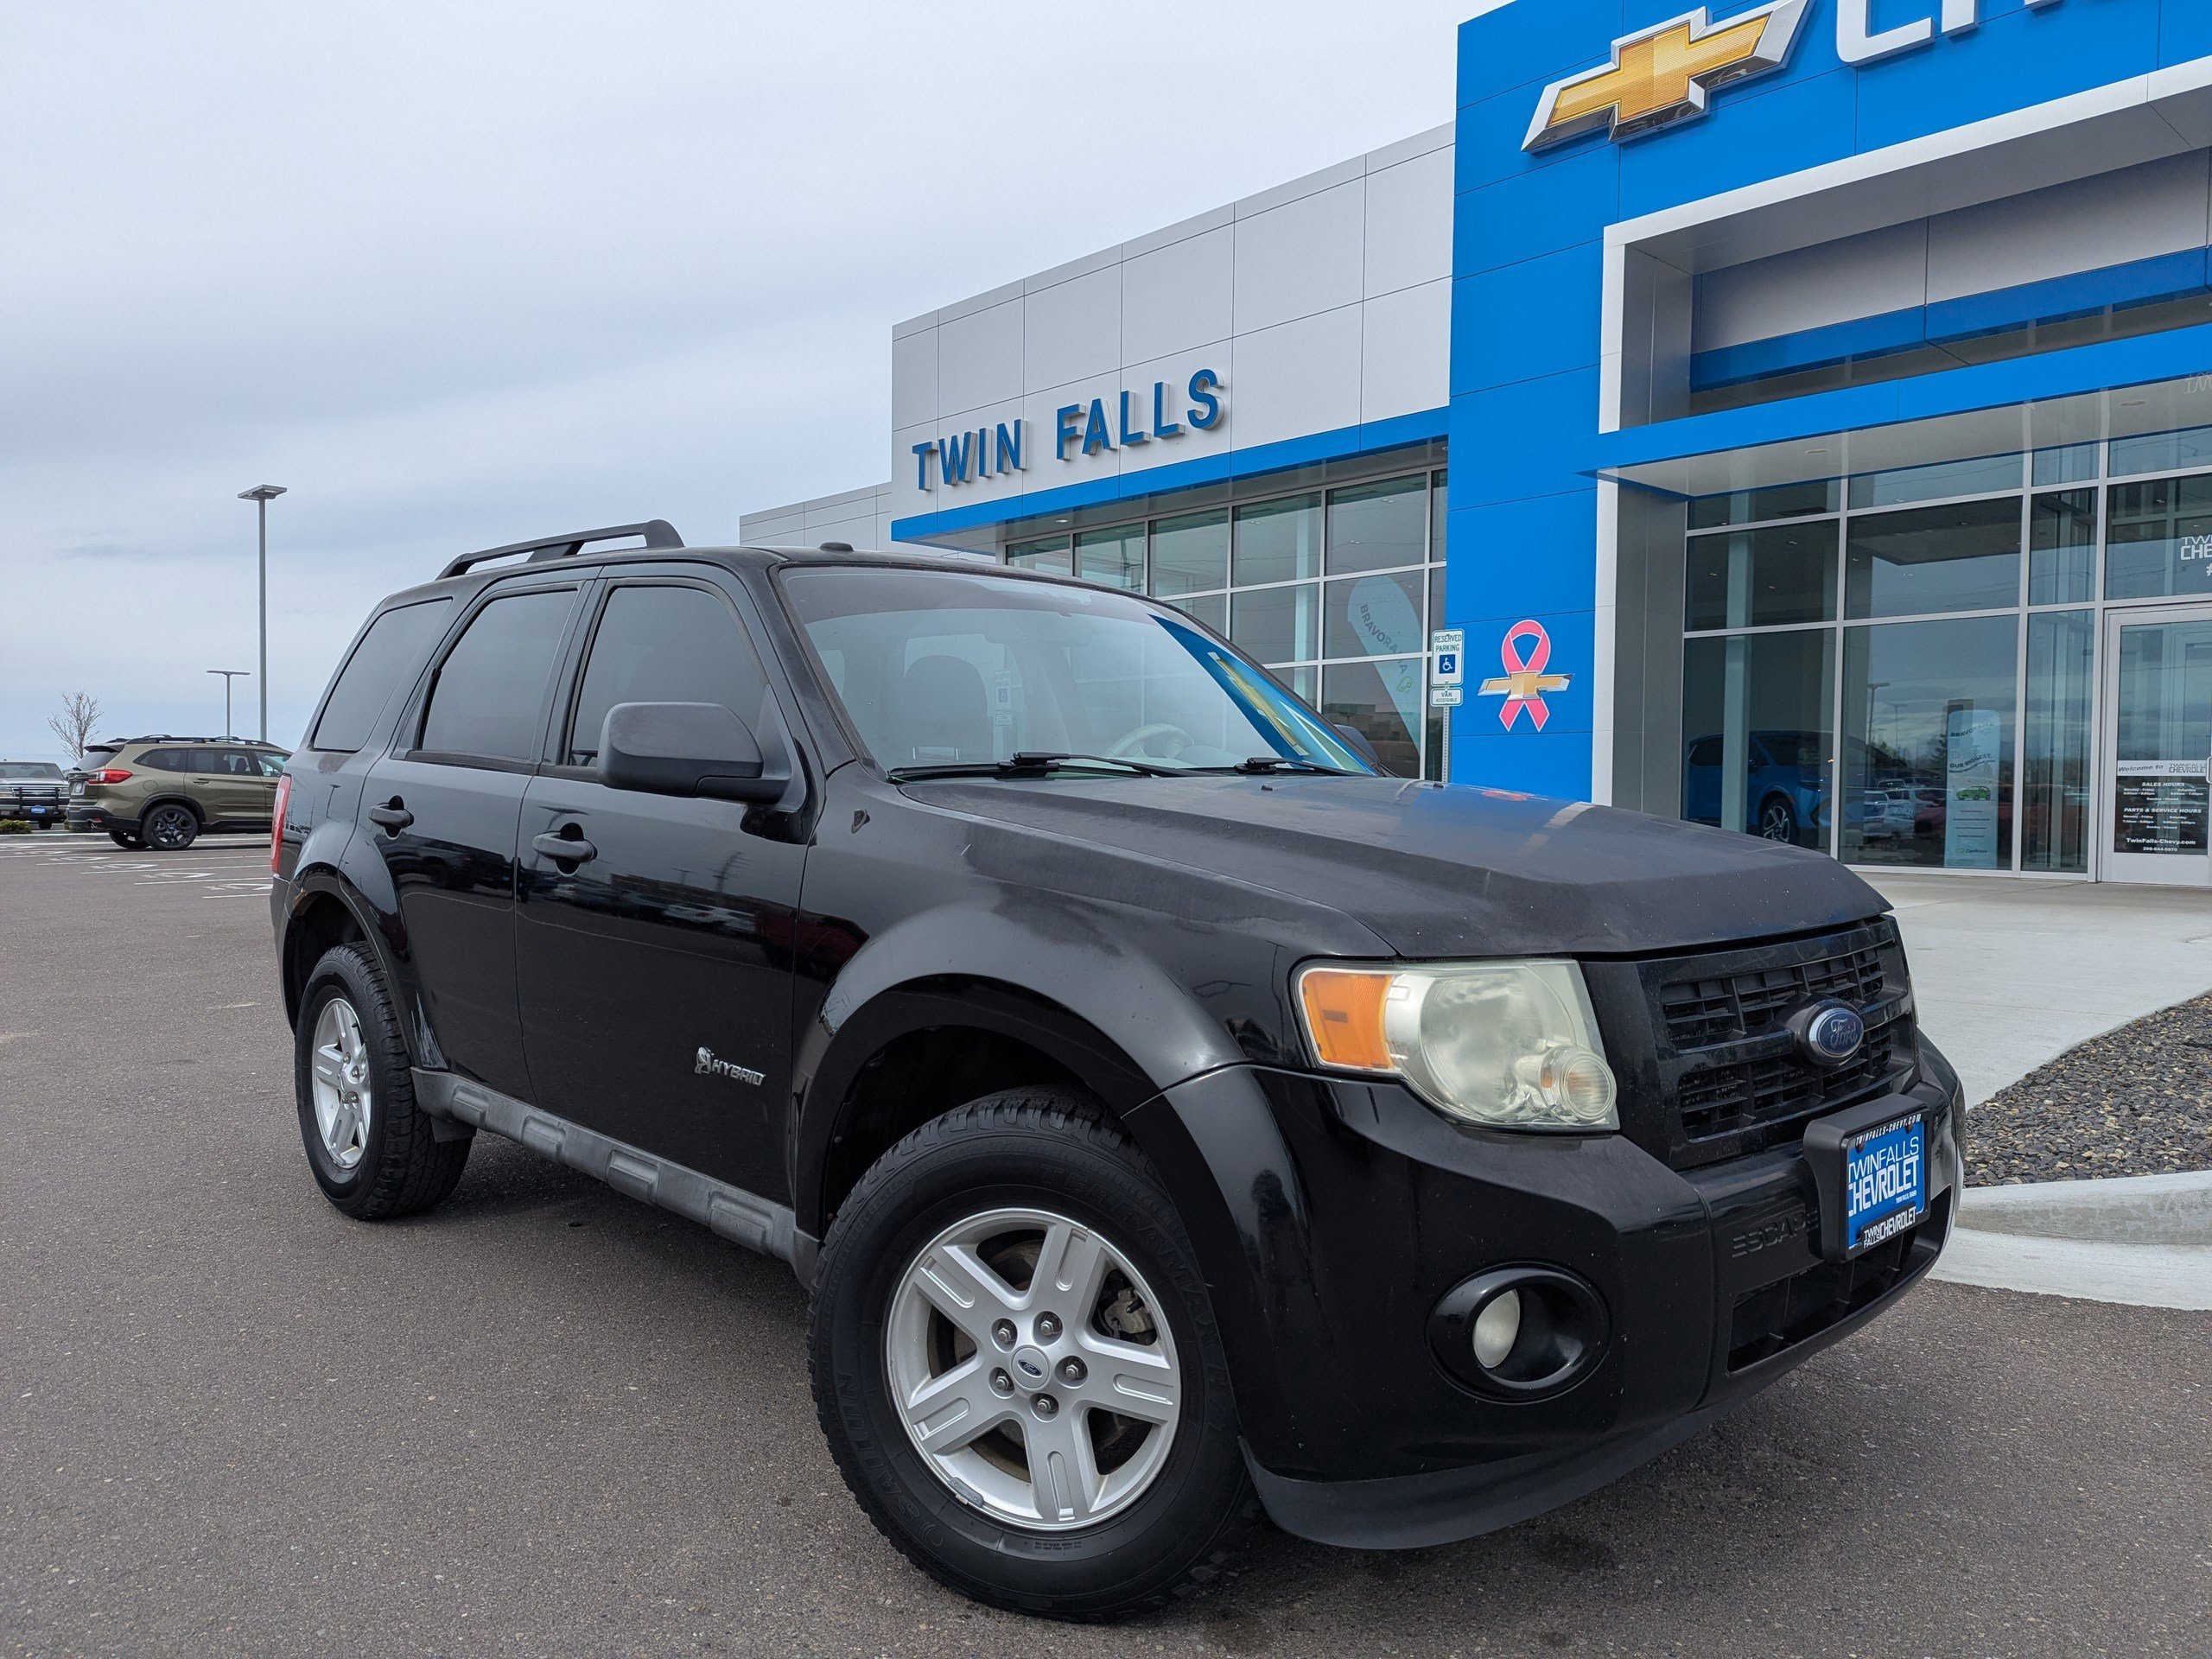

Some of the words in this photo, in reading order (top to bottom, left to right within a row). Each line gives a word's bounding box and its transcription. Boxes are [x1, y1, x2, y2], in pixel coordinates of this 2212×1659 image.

[912, 419, 1027, 492] TWIN
[1057, 369, 1224, 461] FALLS
[1360, 604, 1408, 674] BRAVORAA
[1434, 634, 1462, 643] RESERVED
[1435, 644, 1460, 652] PARKING
[1831, 1018, 1858, 1049] Ford
[712, 1059, 766, 1086] HYBRID
[1855, 1113, 1922, 1147] TWINFALLS-CHEVY.COM
[1848, 1136, 1919, 1184] TWINFALLS
[1864, 1224, 1880, 1241] TWIN
[1879, 1206, 1916, 1240] CHEVROLET
[1863, 1233, 1880, 1249] FALLS
[1023, 1362, 1038, 1374] Ford
[833, 1371, 921, 1522] SAILUN
